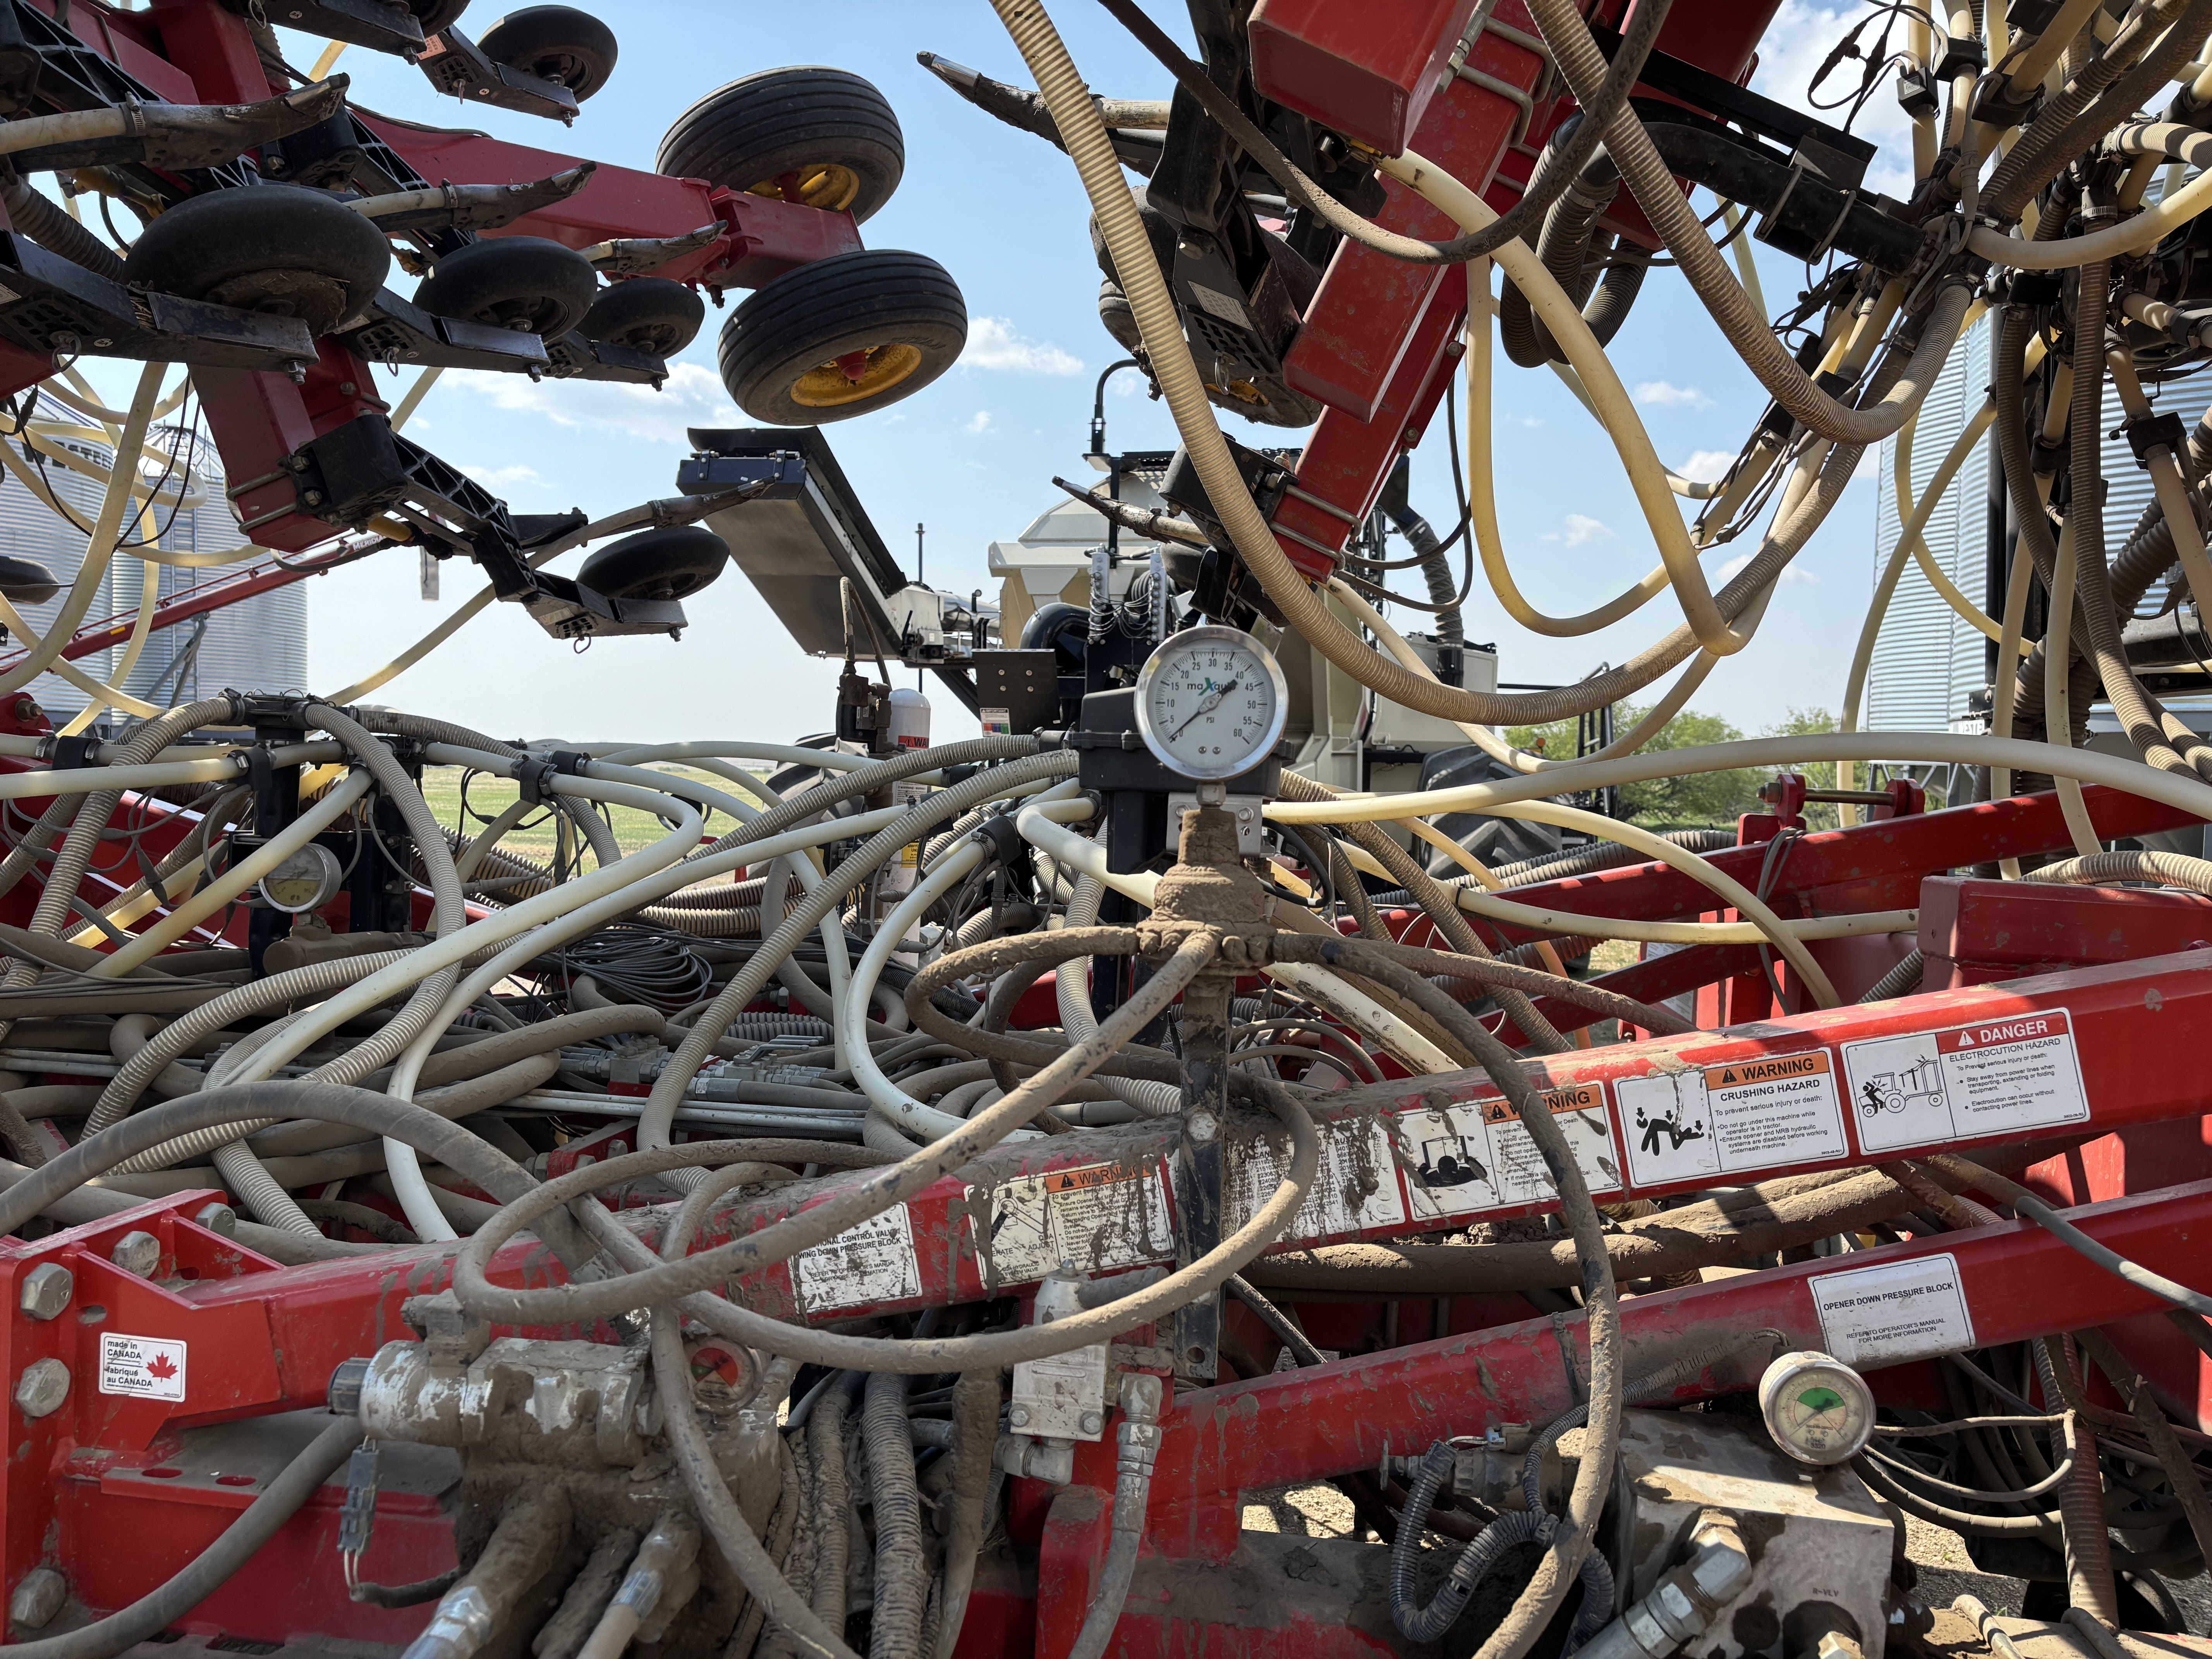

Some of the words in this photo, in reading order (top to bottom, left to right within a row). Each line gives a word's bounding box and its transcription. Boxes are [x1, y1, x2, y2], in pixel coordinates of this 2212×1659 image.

[1192, 662, 1200, 671] 25
[1209, 659, 1216, 667] 30
[1224, 662, 1232, 671] 35
[1181, 670, 1188, 679] 20
[1235, 671, 1243, 679] 40
[1171, 682, 1179, 690] 15
[1243, 716, 1252, 725] 55
[1234, 729, 1242, 737] 60
[1980, 1019, 2048, 1042] DANGER
[1949, 1044, 2023, 1062] ELECTROCUTION
[2025, 1037, 2061, 1049] HAZARD
[1741, 1058, 1814, 1080] WARNING
[1968, 1079, 2001, 1089] transporting,
[2002, 1074, 2029, 1084] extending
[1720, 1086, 1774, 1101] CRUSHING
[1777, 1079, 1820, 1092] HAZARD
[1969, 1085, 1999, 1095] equipment.
[1724, 1106, 1749, 1115] prevent
[1750, 1102, 1773, 1111] serious
[1775, 1099, 1793, 1108] injury
[1802, 1094, 1822, 1103] death:
[1972, 1097, 2006, 1106] Electrocution
[1973, 1104, 2000, 1113] contacting
[1502, 1126, 1522, 1134] prevent
[1726, 1127, 1749, 1135] operator
[1791, 1123, 1816, 1133] hydraulic
[1728, 1140, 1751, 1149] systems
[1762, 1135, 1786, 1143] disabled
[1806, 1129, 1827, 1138] working
[1729, 1145, 1760, 1154] underneath
[1762, 1141, 1787, 1150] machine.
[1508, 1158, 1543, 1168] understanding
[1060, 1190, 1082, 1199] prevent
[842, 1232, 874, 1243] CONTROL
[798, 1250, 816, 1259] WING
[840, 1241, 876, 1252] PRESSURE
[878, 1237, 901, 1247] BLOCK
[1028, 1241, 1054, 1251] ADJUST
[1823, 1298, 1855, 1310] OPENER
[1856, 1294, 1881, 1305] DOWN
[1882, 1286, 1925, 1300] PRESSURE
[1925, 1281, 1953, 1293] BLOCK
[1846, 1330, 1869, 1339] REFER
[1878, 1322, 1918, 1334] OPERATOR'S
[1919, 1317, 1946, 1327] MANUAL
[1872, 1333, 1893, 1341] MORE
[1893, 1325, 1936, 1338] INFORMATION
[107, 1349, 142, 1359] CANADA
[107, 1366, 138, 1376] fabriqué
[118, 1377, 153, 1387] CANADA
[1813, 1587, 1839, 1597] R-VLV
